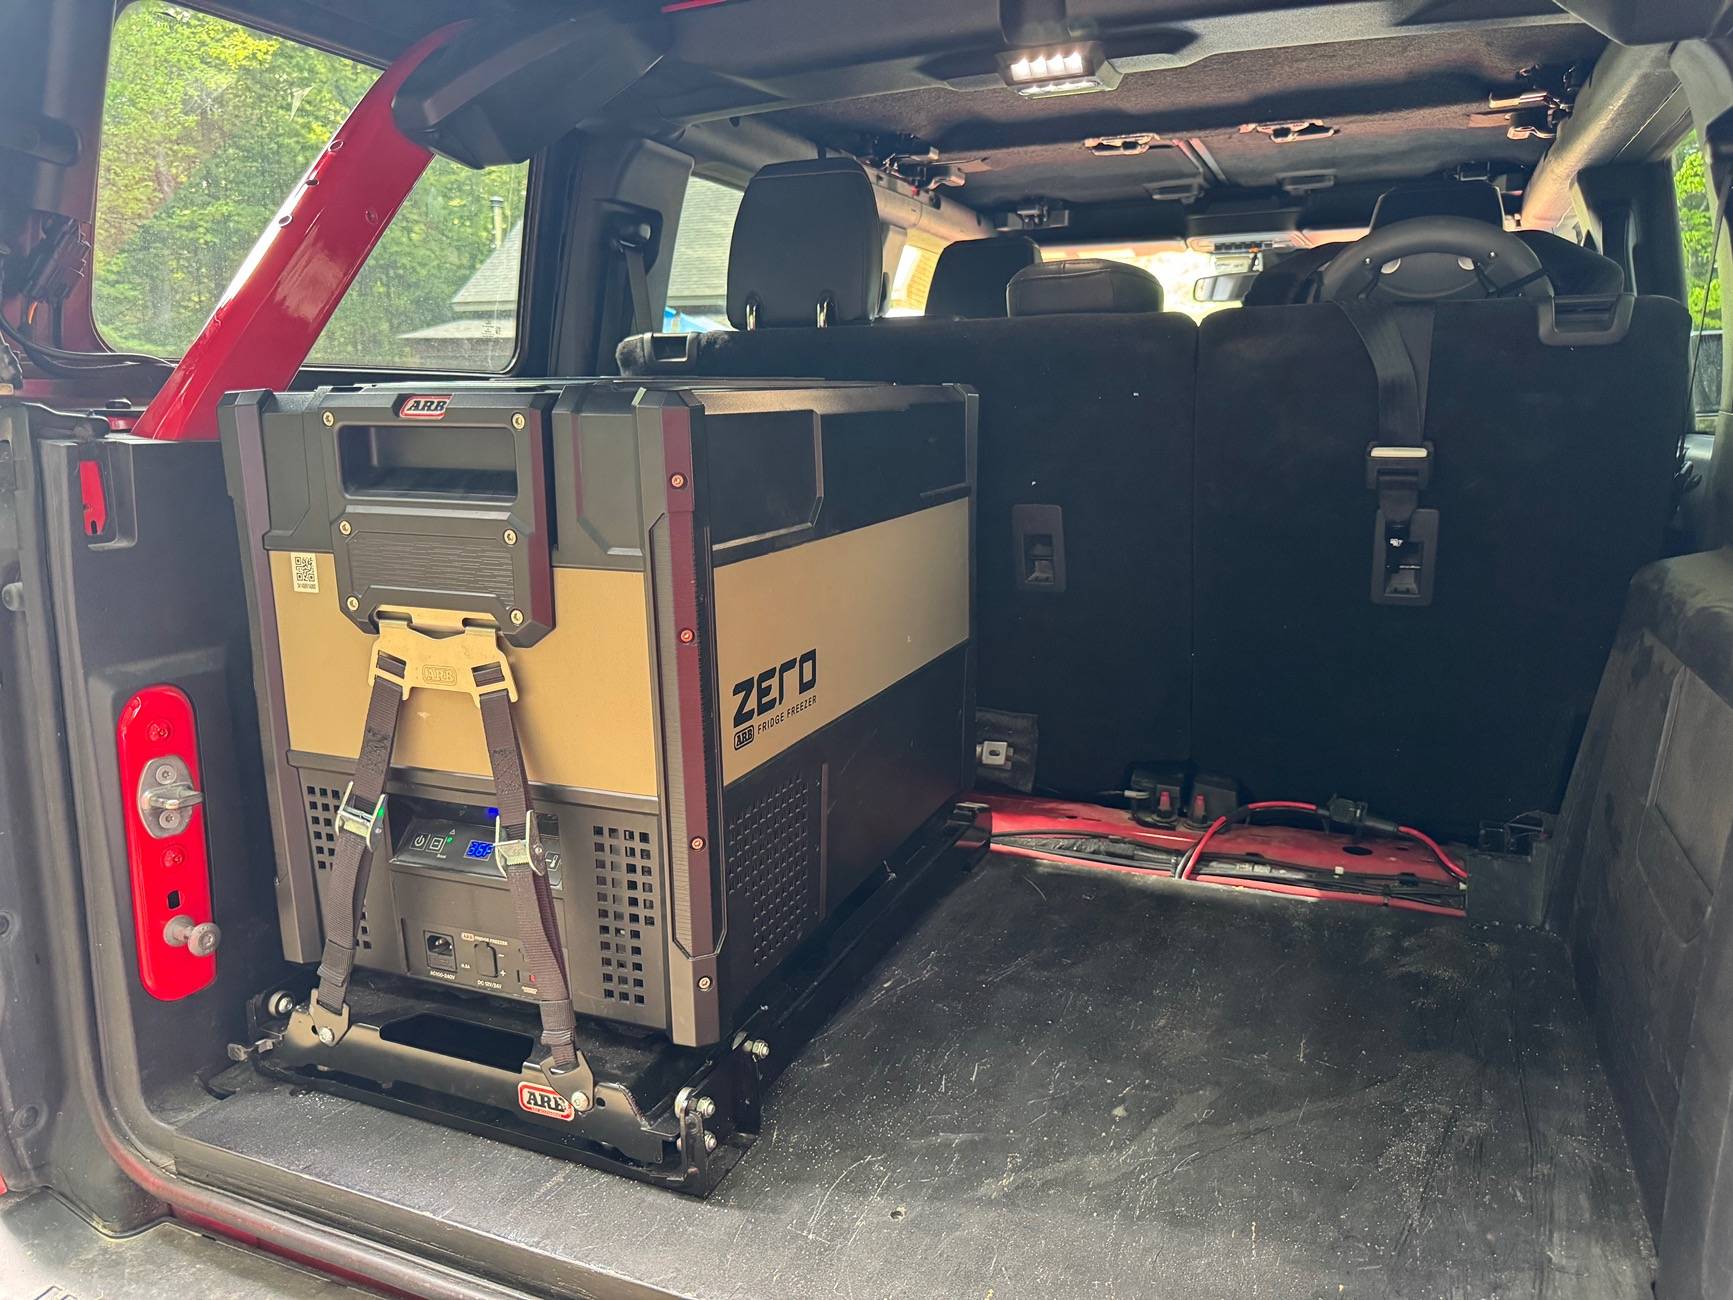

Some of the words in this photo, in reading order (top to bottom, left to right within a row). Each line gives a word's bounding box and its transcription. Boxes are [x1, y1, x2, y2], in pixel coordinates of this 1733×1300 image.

[406, 400, 448, 411] ARB
[736, 728, 753, 747] ARB
[758, 712, 785, 734] FRIDGE
[787, 695, 817, 718] FREEZER
[467, 842, 494, 858] 36F
